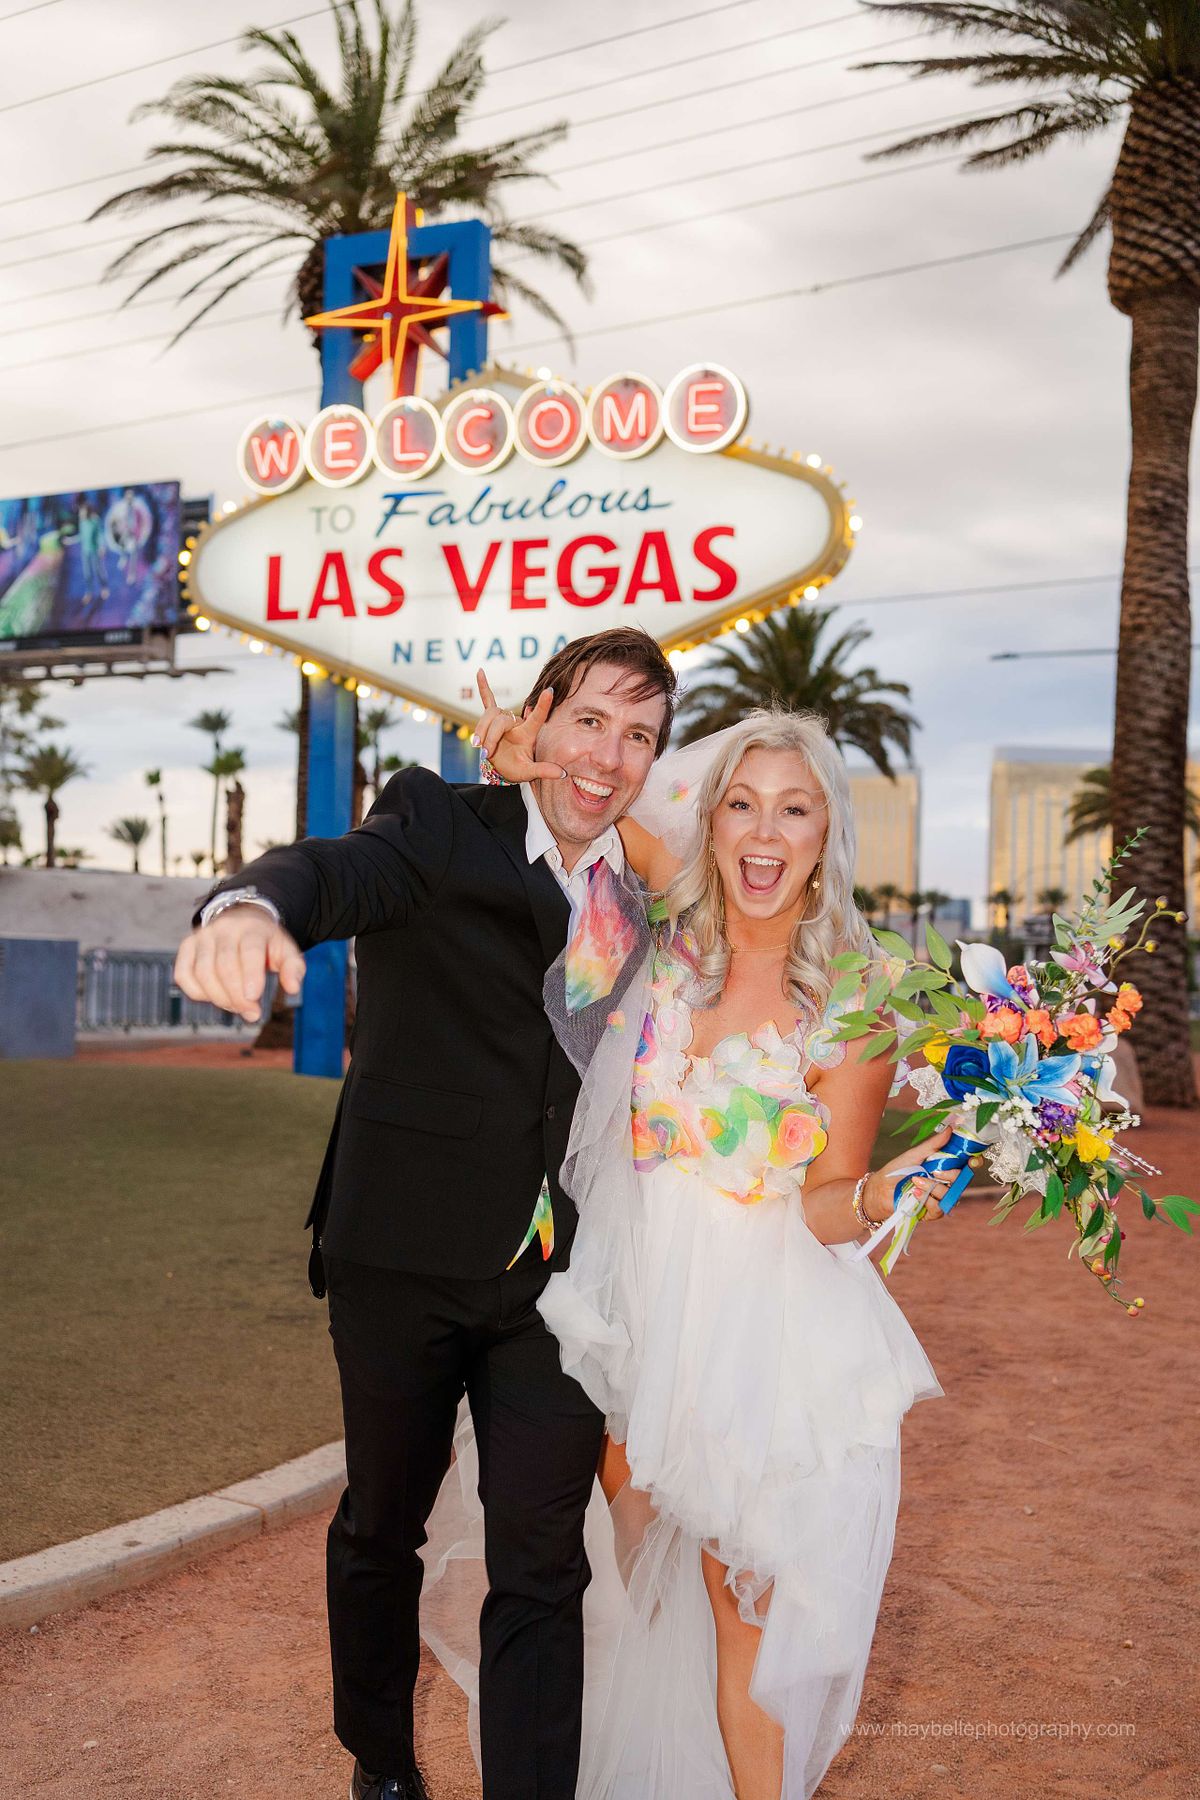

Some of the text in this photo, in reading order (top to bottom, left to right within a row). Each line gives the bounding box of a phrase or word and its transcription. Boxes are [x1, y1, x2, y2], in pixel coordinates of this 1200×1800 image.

[250, 380, 726, 480] WELCOME
[309, 478, 674, 537] TO Fabulous
[266, 526, 738, 621] LAS VEGAS
